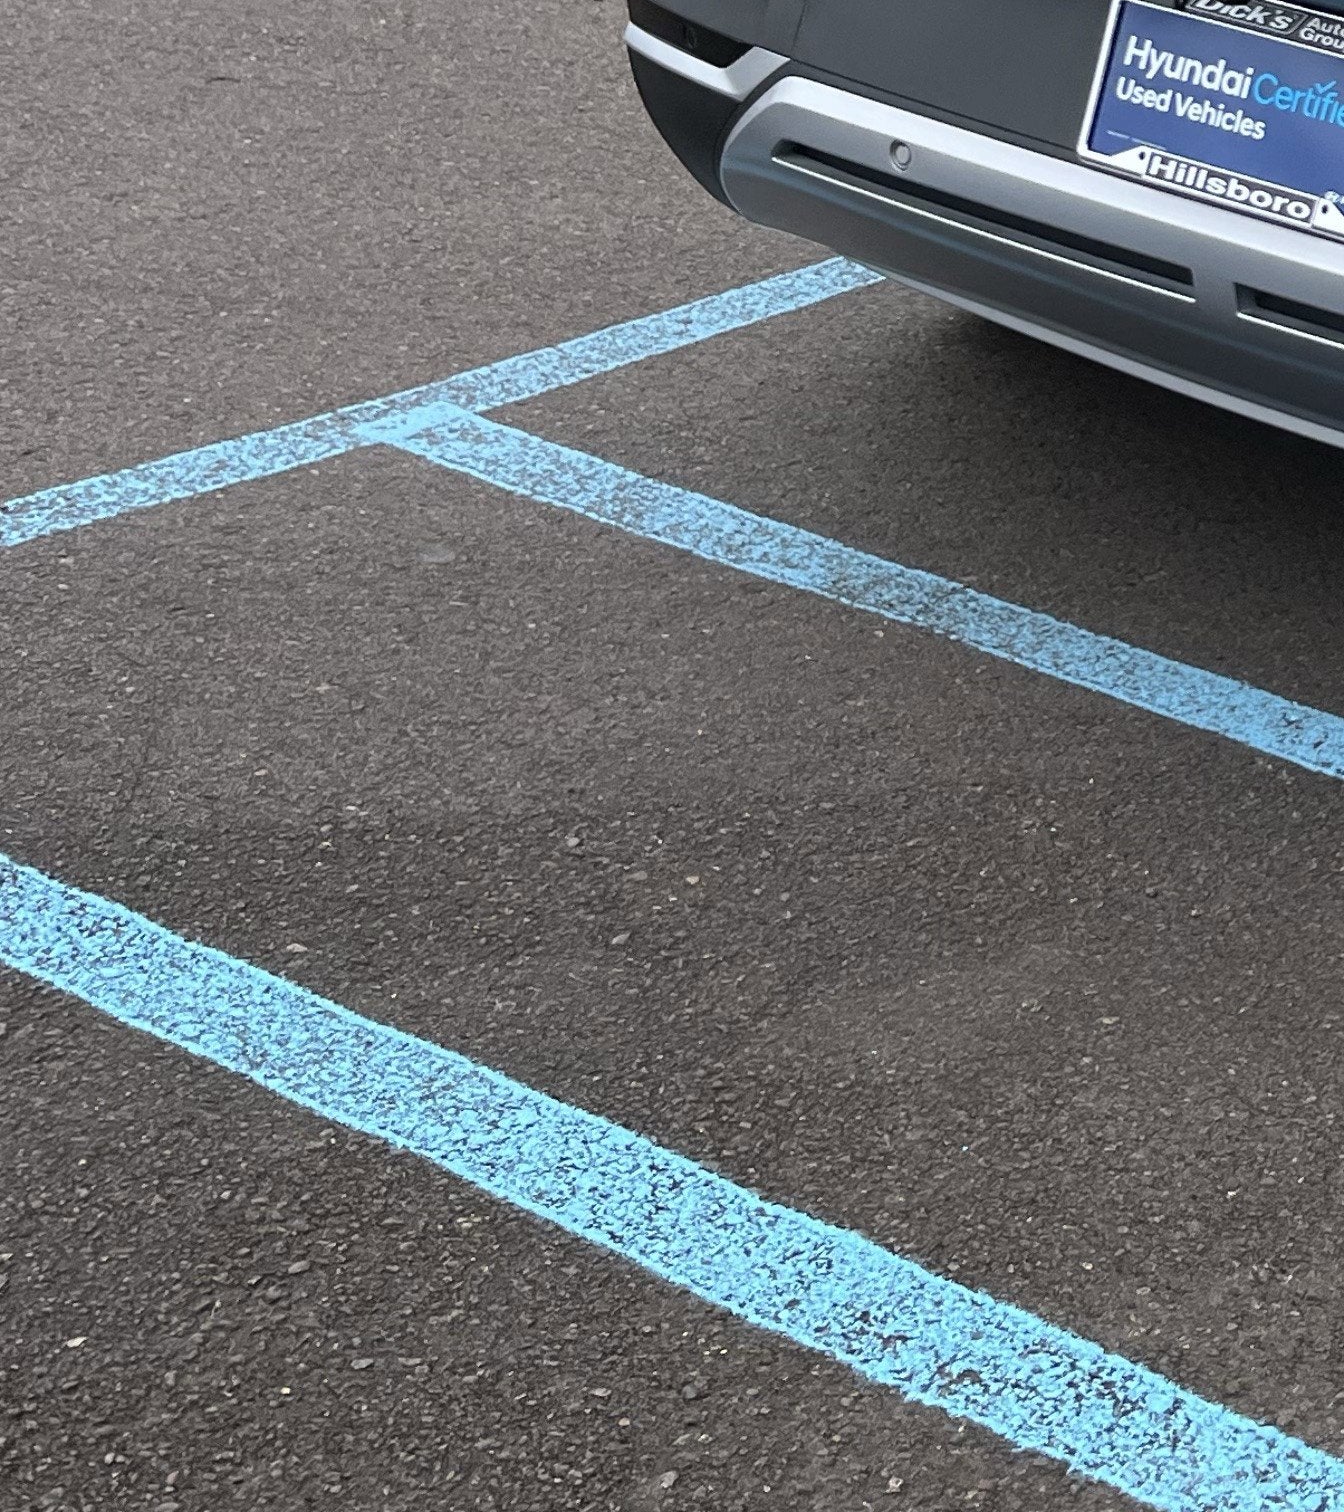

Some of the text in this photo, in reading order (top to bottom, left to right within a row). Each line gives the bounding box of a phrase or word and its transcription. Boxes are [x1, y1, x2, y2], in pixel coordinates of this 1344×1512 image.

[1123, 35, 1254, 99] Hyundai
[1116, 76, 1171, 113] Used
[1174, 92, 1266, 140] Vehicles
[1150, 154, 1311, 220] Hillsboro
